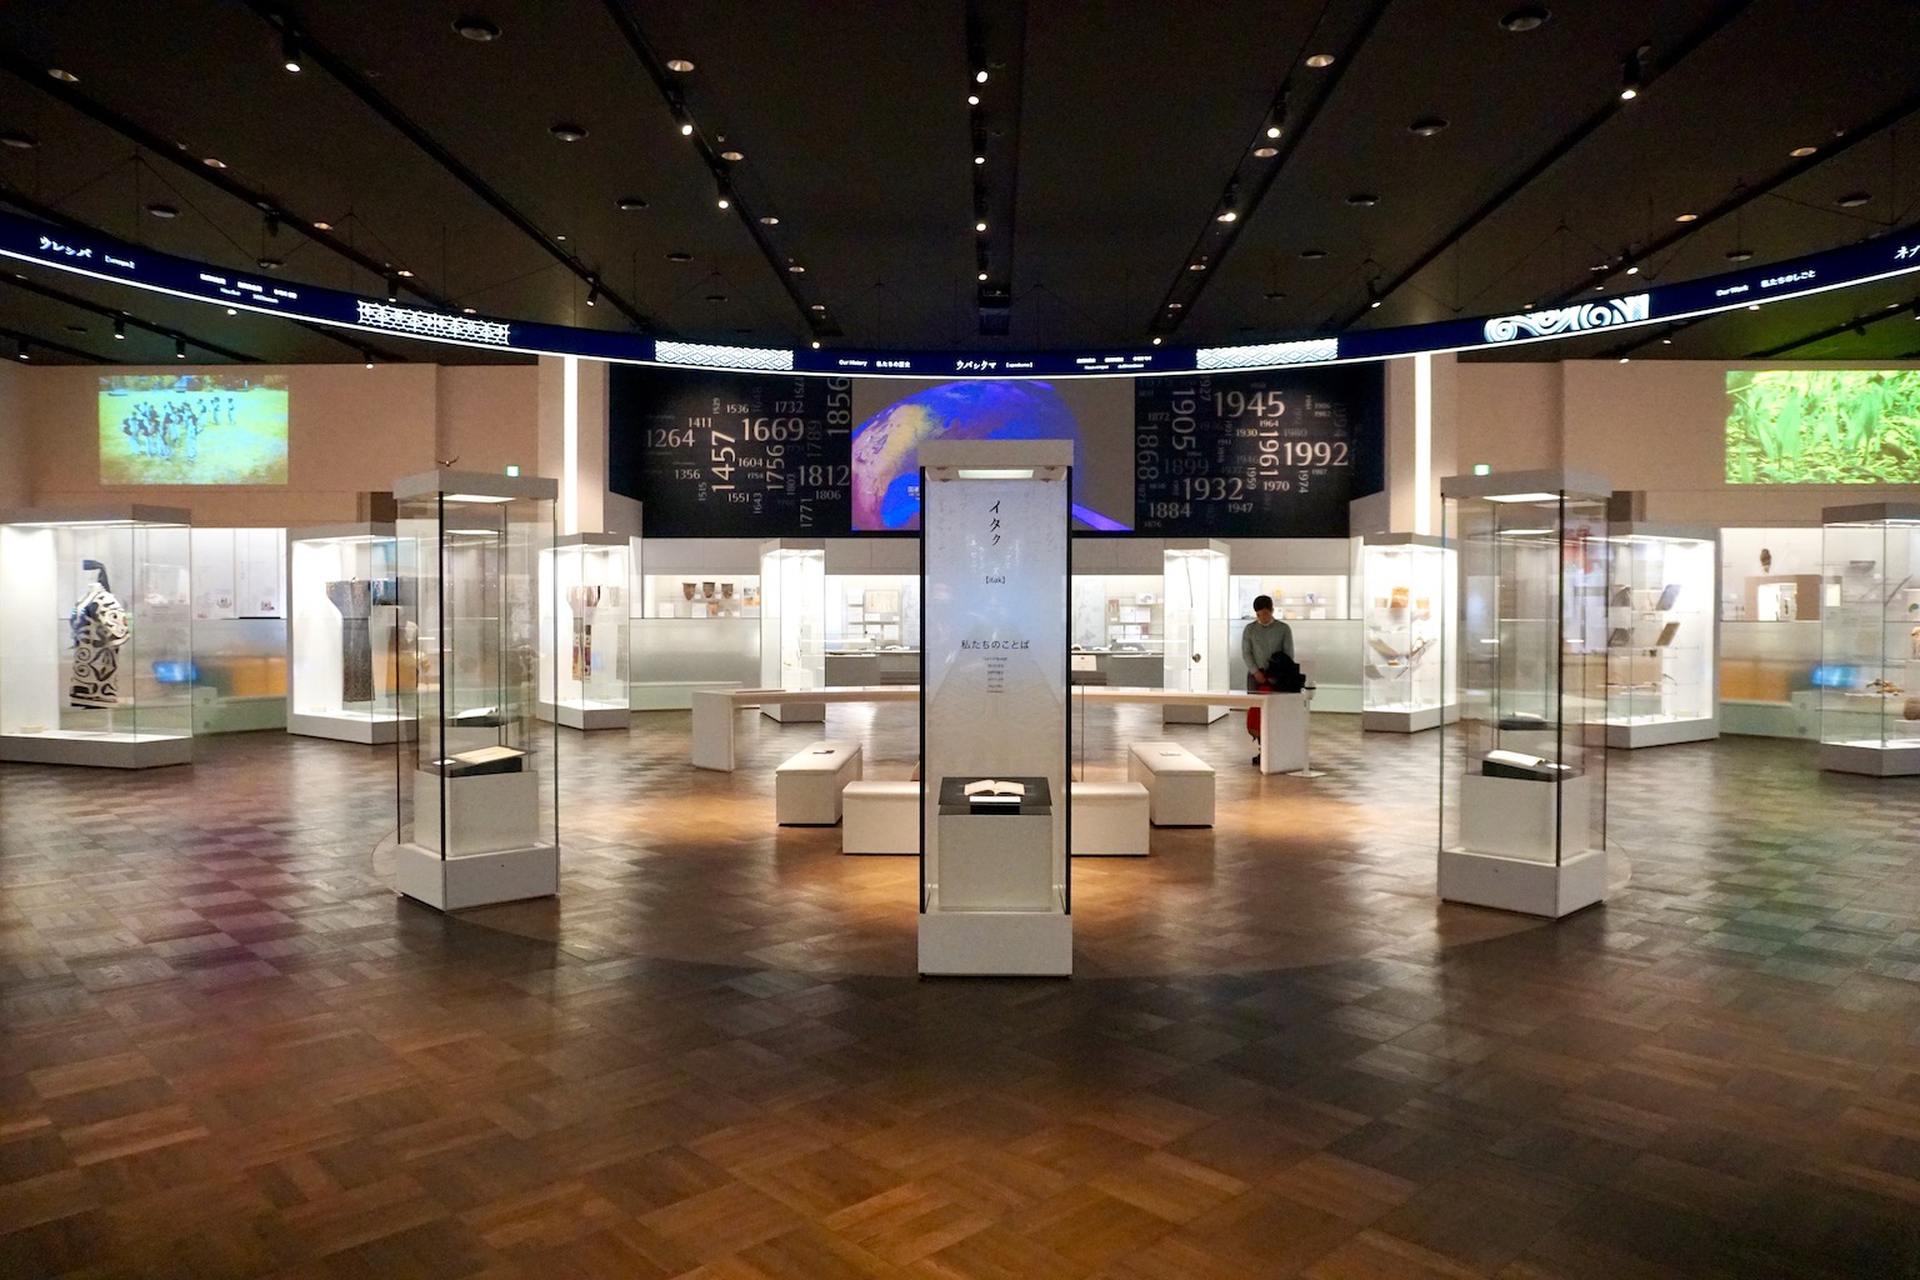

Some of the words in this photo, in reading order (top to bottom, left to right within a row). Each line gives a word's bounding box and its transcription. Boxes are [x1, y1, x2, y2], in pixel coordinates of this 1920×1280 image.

[726, 404, 749, 414] 1536
[774, 401, 804, 414] 1732
[827, 377, 850, 436] 1856
[1214, 390, 1286, 418] 1945
[688, 417, 712, 428] 1411
[741, 417, 805, 442] 1669
[1172, 389, 1196, 450] 1905
[646, 428, 696, 448] 1264
[1236, 429, 1259, 438] 1930
[711, 430, 736, 493] 1457
[738, 457, 764, 468] 1604
[1137, 425, 1160, 480] 1868
[1259, 430, 1279, 478] 1961
[1283, 442, 1349, 467] 1992
[675, 469, 700, 480] 1356
[766, 444, 785, 491] 1756
[800, 465, 850, 487] 1812
[1183, 477, 1243, 501] 1932
[1263, 481, 1290, 492] 1970
[1299, 470, 1309, 494] 1974
[728, 493, 750, 503] 1551
[800, 498, 813, 528] 1771
[1150, 502, 1192, 518] 1884
[961, 640, 1030, 650] 私たちのことば
